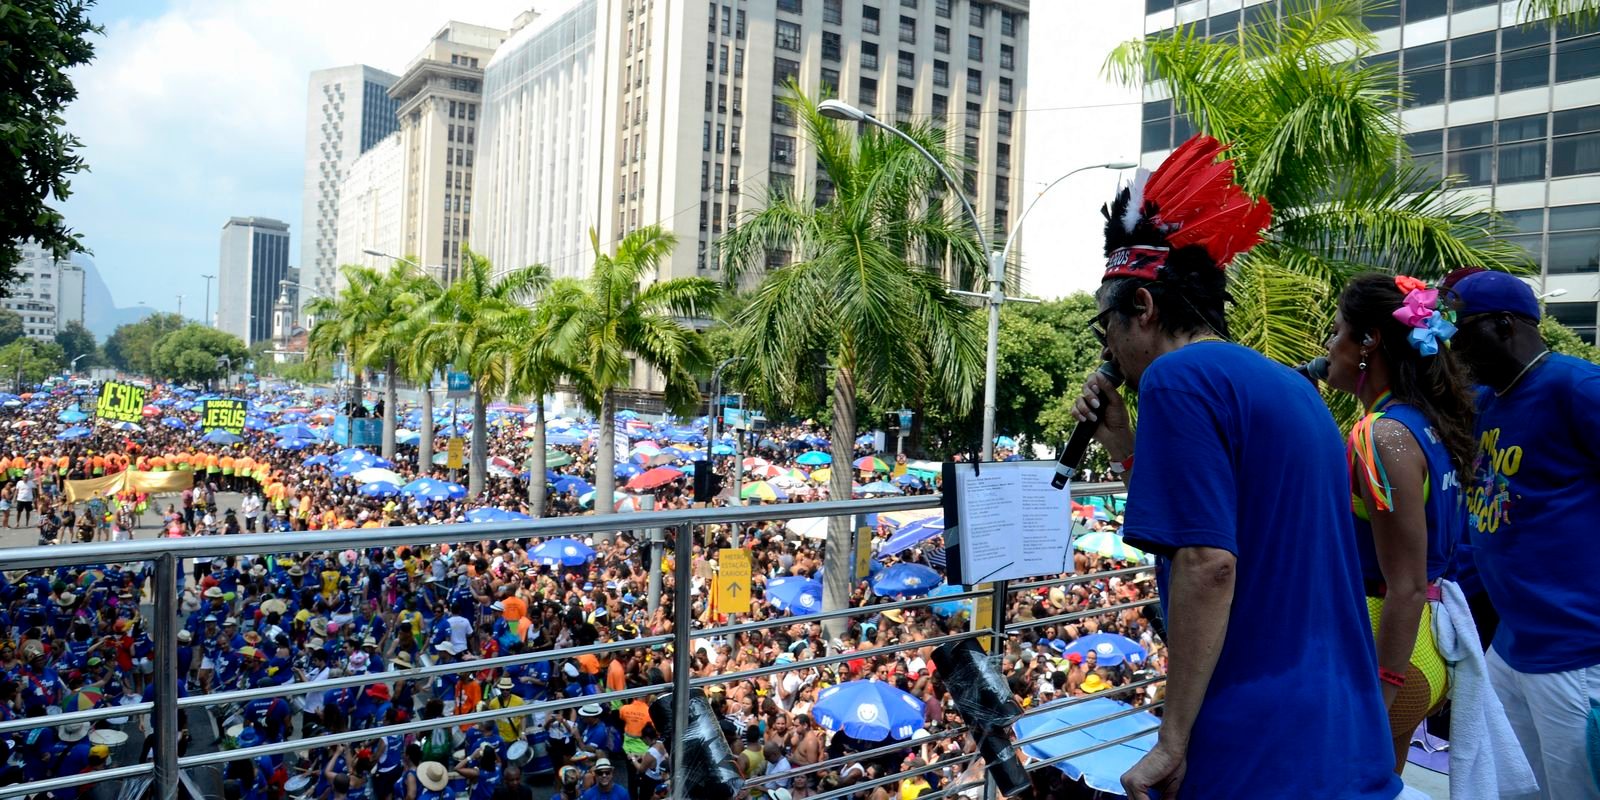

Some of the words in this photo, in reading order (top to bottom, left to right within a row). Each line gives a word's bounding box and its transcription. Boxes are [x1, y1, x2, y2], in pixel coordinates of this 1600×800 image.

[97, 381, 144, 415] JESUS
[207, 400, 234, 408] BUSQUE
[235, 401, 243, 409] A
[202, 409, 246, 427] JESUS
